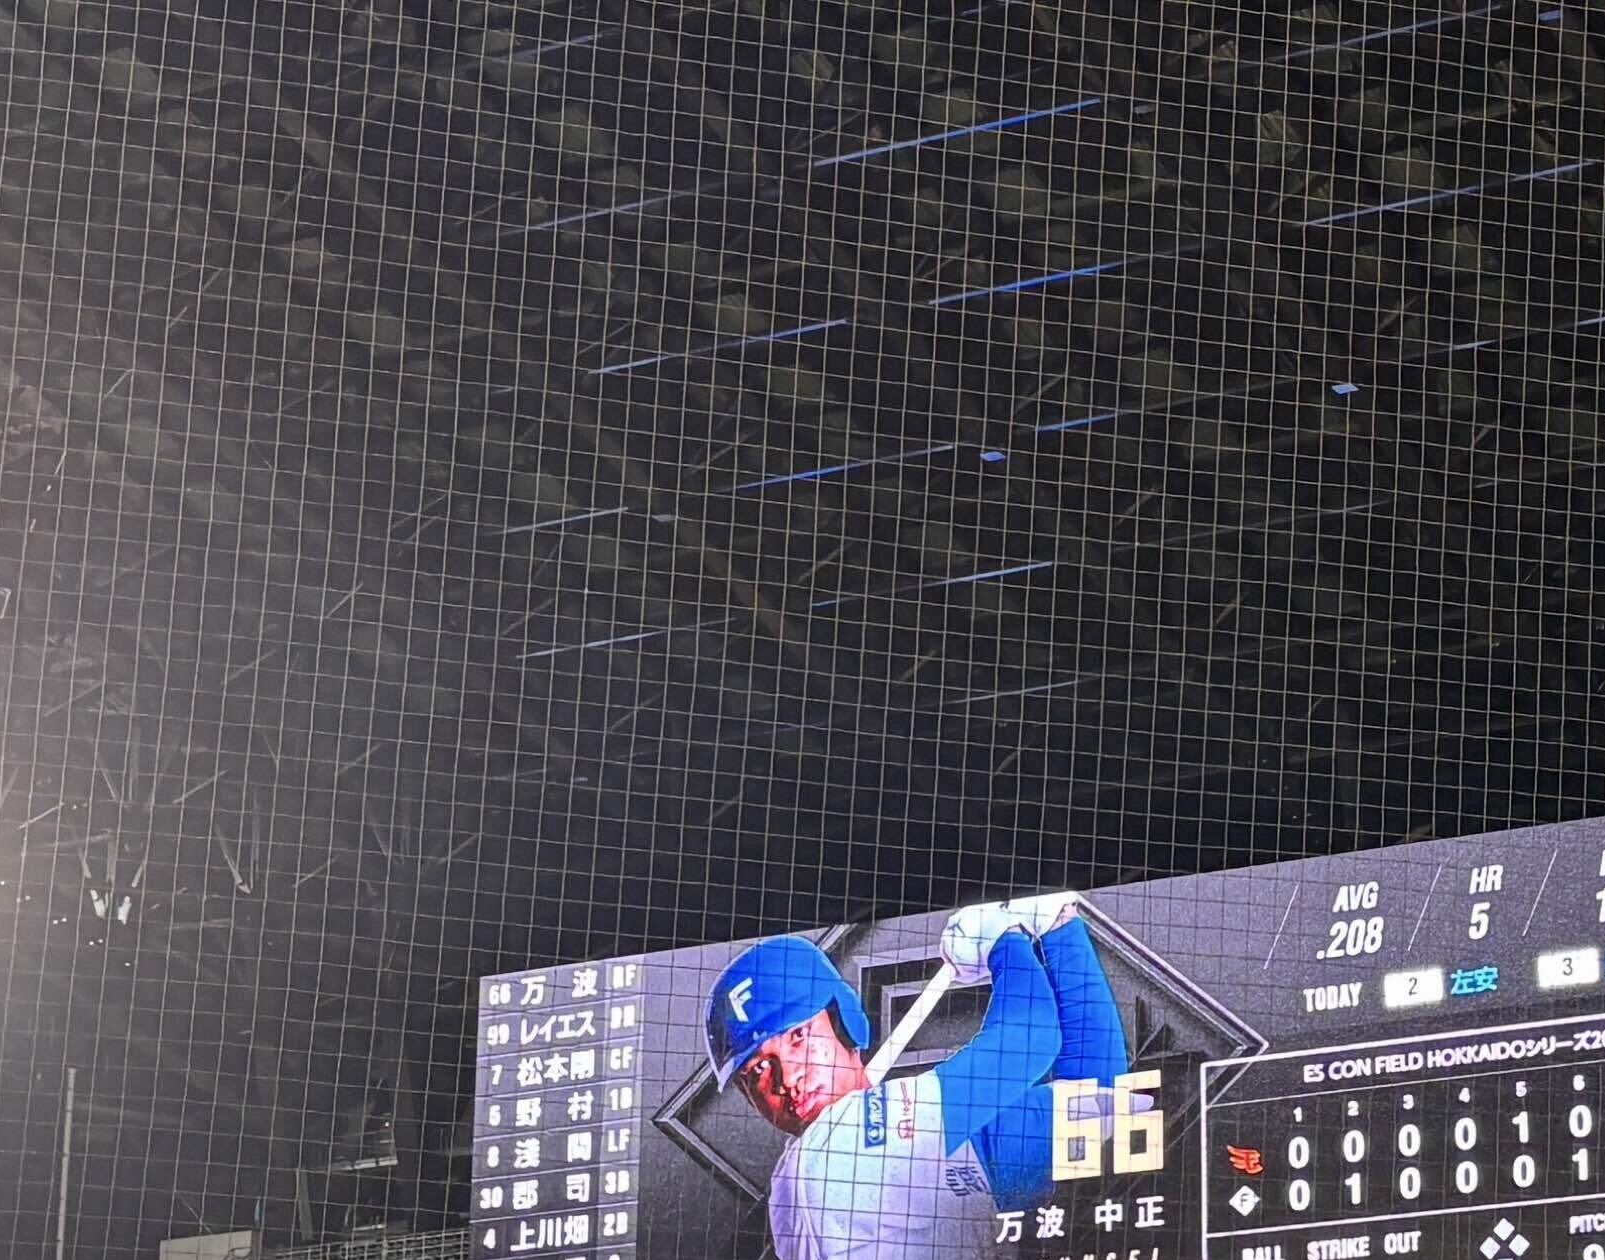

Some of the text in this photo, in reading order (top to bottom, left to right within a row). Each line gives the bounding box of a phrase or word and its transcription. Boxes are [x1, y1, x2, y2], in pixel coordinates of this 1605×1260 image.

[1332, 881, 1379, 912] AVG
[1469, 864, 1503, 894] HR
[1315, 917, 1385, 962] .208
[1469, 903, 1490, 941] 5
[1304, 982, 1363, 1013] TODAY
[1450, 966, 1500, 996] 左安
[520, 1011, 595, 1045] レイエス
[1303, 1063, 1325, 1082] ES
[1328, 1057, 1371, 1080] CON
[1375, 1051, 1424, 1075] FIELD
[1052, 1069, 1163, 1181] 66
[1288, 1136, 1310, 1170] 0
[1343, 1129, 1365, 1164] 0
[1398, 1124, 1421, 1157] 0
[1454, 1117, 1477, 1151] 0
[1512, 1111, 1529, 1143] 1
[1569, 1104, 1593, 1138] 0
[1289, 1179, 1310, 1211] 0
[1345, 1172, 1362, 1205] 1
[1571, 1148, 1589, 1181] 1
[510, 1214, 589, 1252] 上川畑
[996, 1196, 1164, 1243] 万波 中正
[1384, 1231, 1422, 1255] OUT
